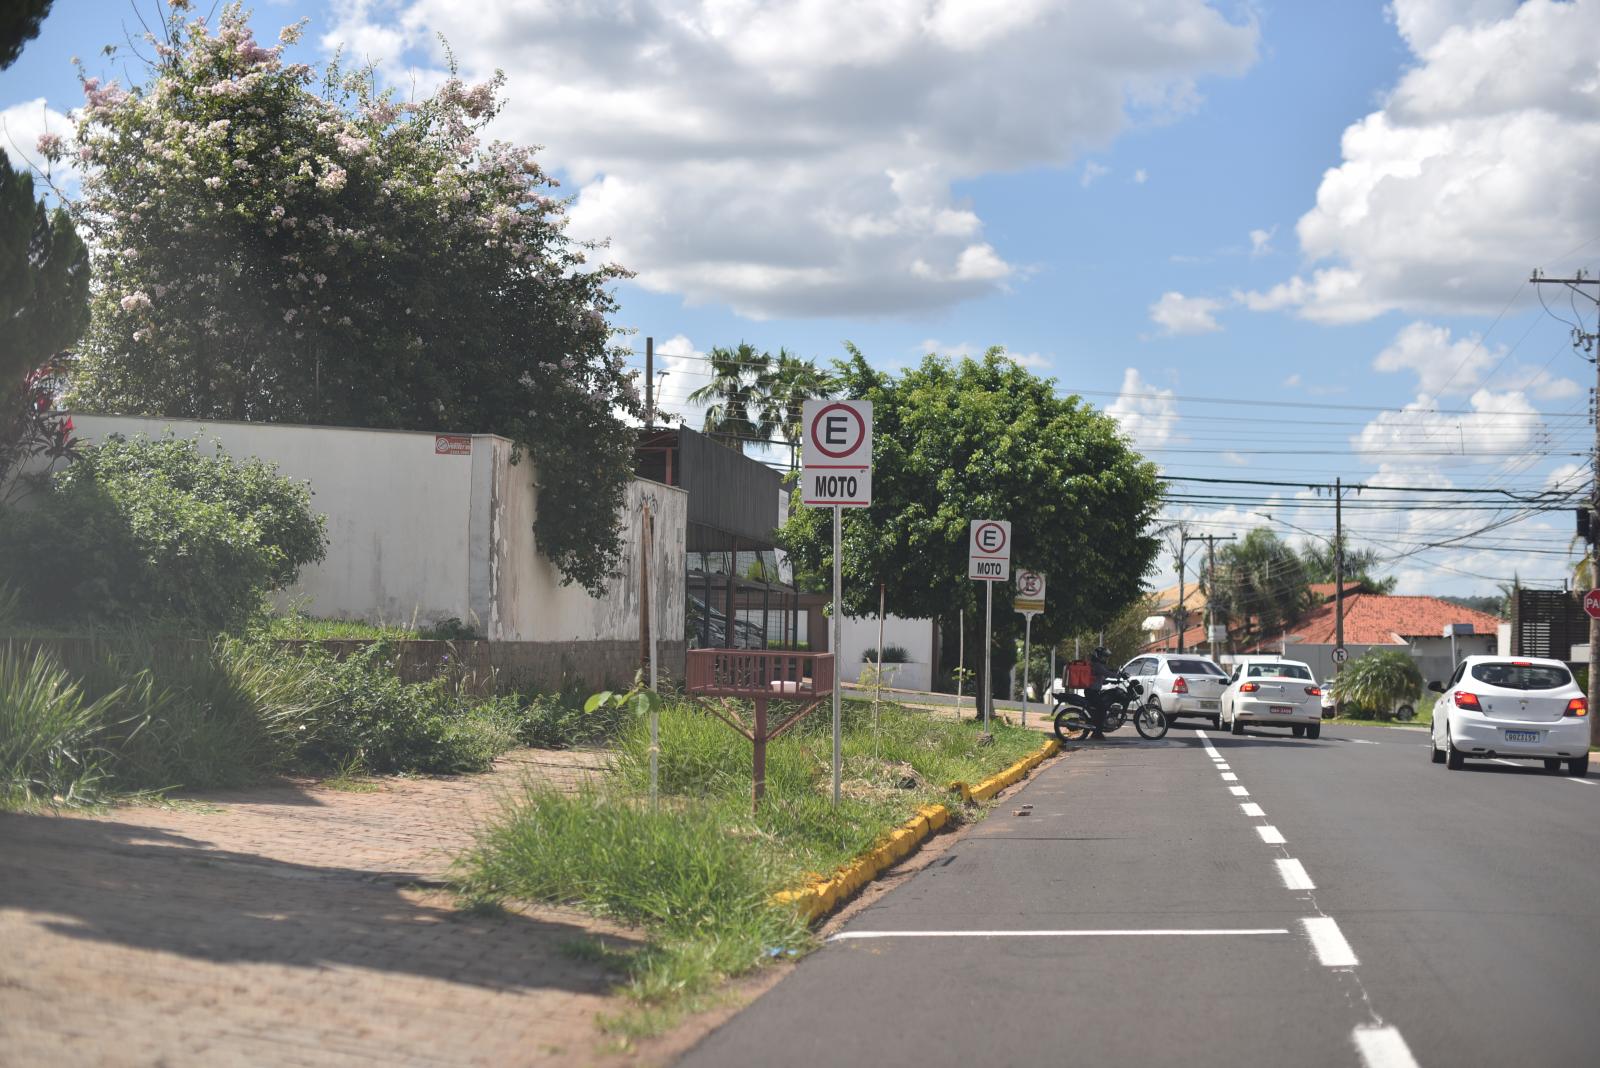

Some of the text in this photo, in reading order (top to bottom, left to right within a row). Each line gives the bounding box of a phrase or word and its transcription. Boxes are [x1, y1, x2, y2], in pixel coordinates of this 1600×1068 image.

[826, 416, 848, 445] E
[815, 475, 858, 498] MOTO
[983, 530, 997, 547] E
[977, 562, 1002, 576] MOTO
[1586, 598, 1600, 609] PA
